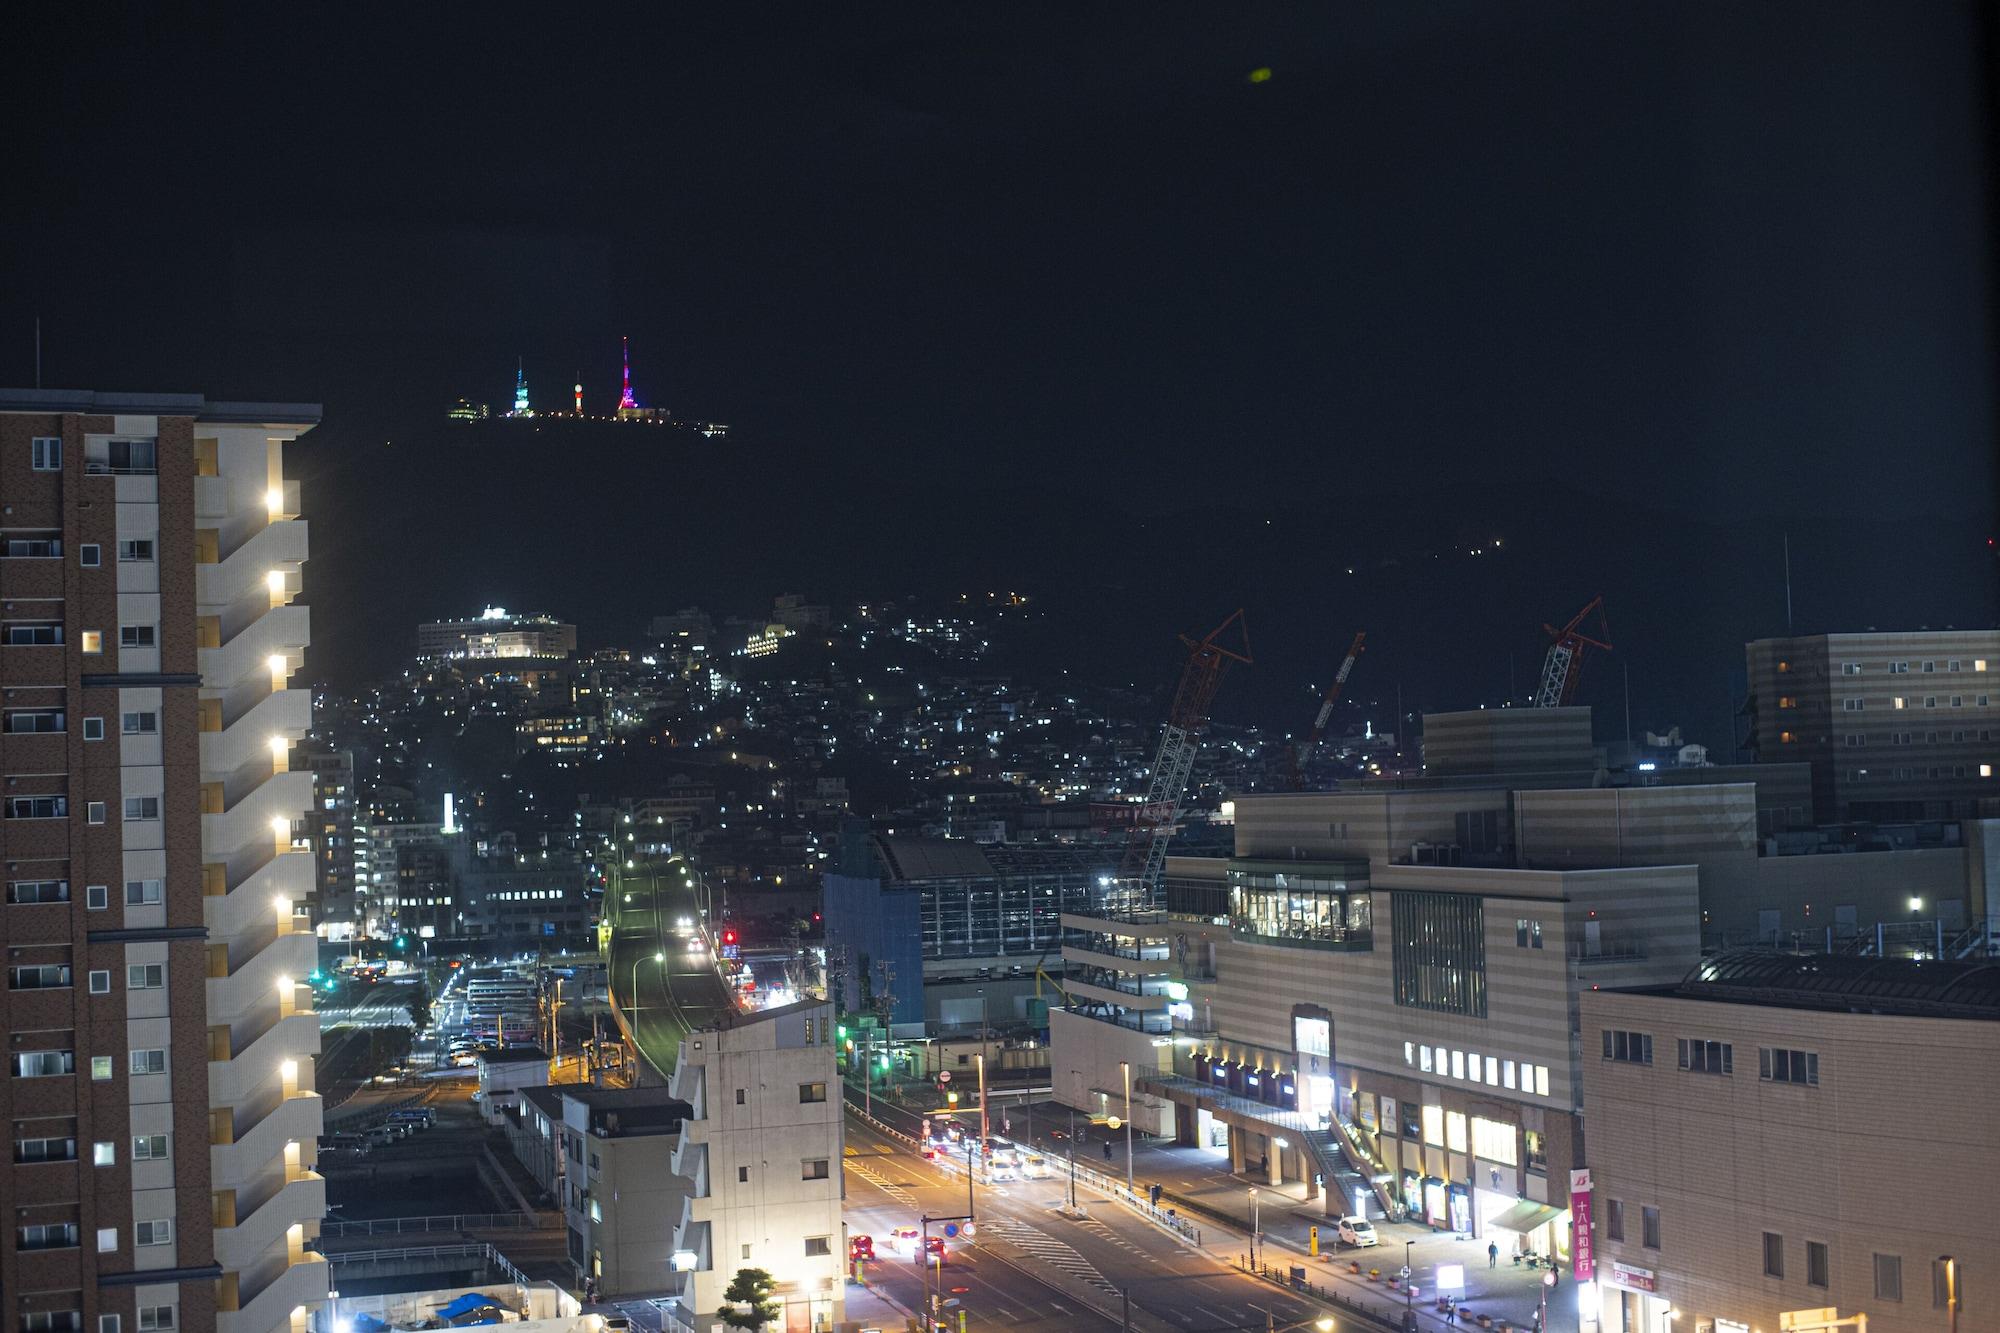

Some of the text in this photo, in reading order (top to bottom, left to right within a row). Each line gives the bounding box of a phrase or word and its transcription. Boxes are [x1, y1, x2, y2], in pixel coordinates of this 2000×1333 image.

[1577, 1201, 1590, 1271] 十八親和銀行
